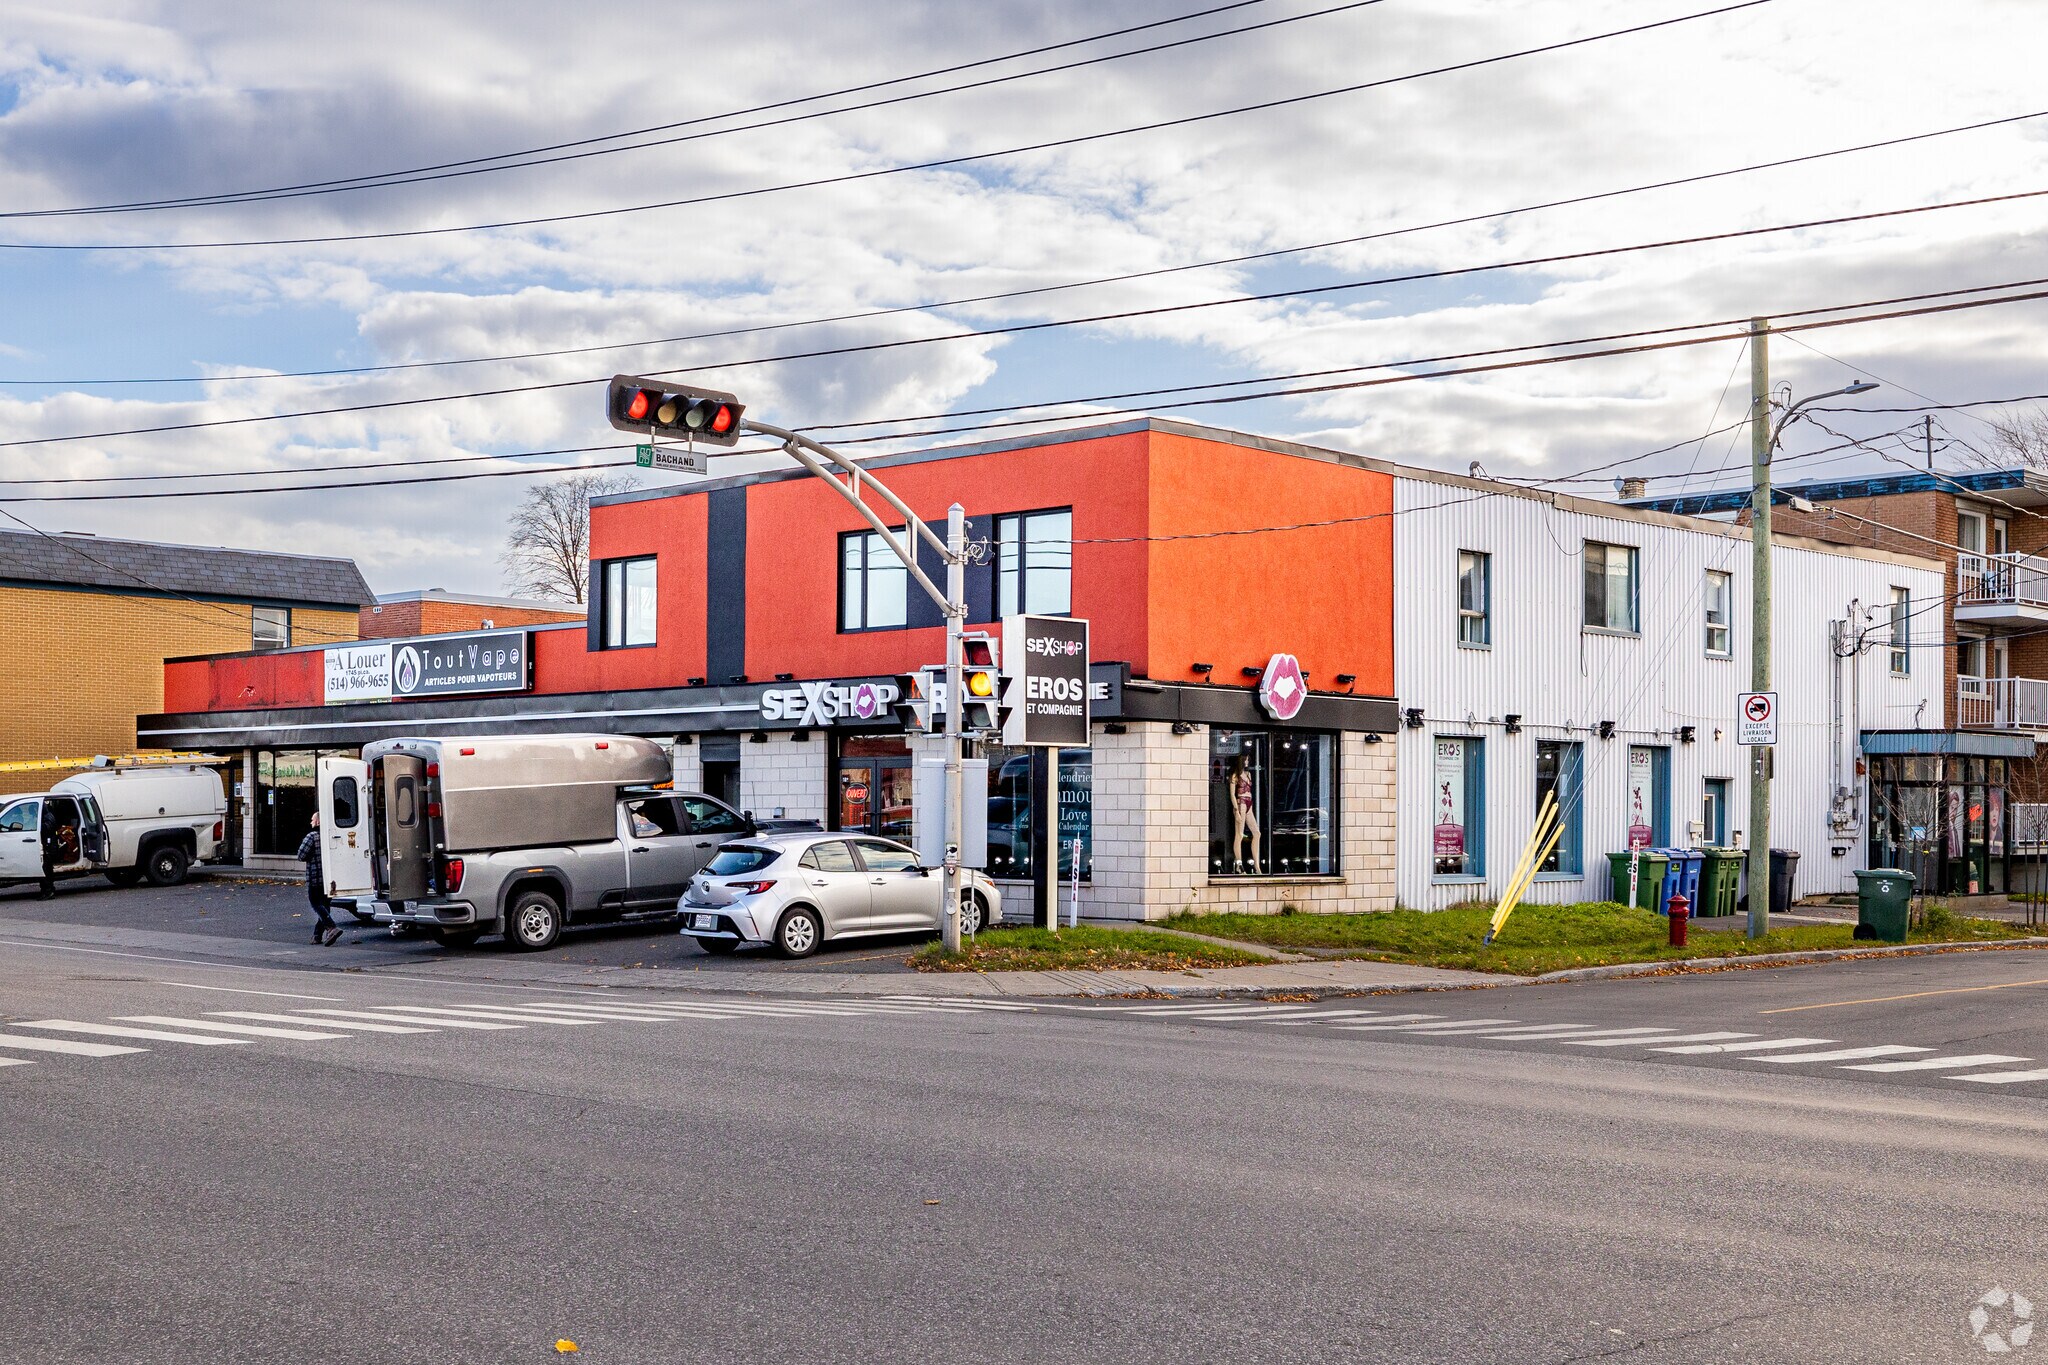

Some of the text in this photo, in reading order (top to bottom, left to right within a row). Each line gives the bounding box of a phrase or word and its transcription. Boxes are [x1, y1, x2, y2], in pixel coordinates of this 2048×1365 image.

[656, 454, 694, 466] BACHAND
[347, 651, 386, 669] Louer
[328, 676, 348, 692] (514)
[424, 671, 517, 687] ARTICLES POUR VAPOTEURS
[1026, 675, 1083, 700] EROS
[1026, 703, 1083, 716] ET COMPAGNIE
[1438, 743, 1461, 756] EROS
[1631, 752, 1649, 763] EROS
[1061, 807, 1088, 821] Love
[1058, 821, 1090, 830] Calendar
[1063, 840, 1084, 849] ERS
